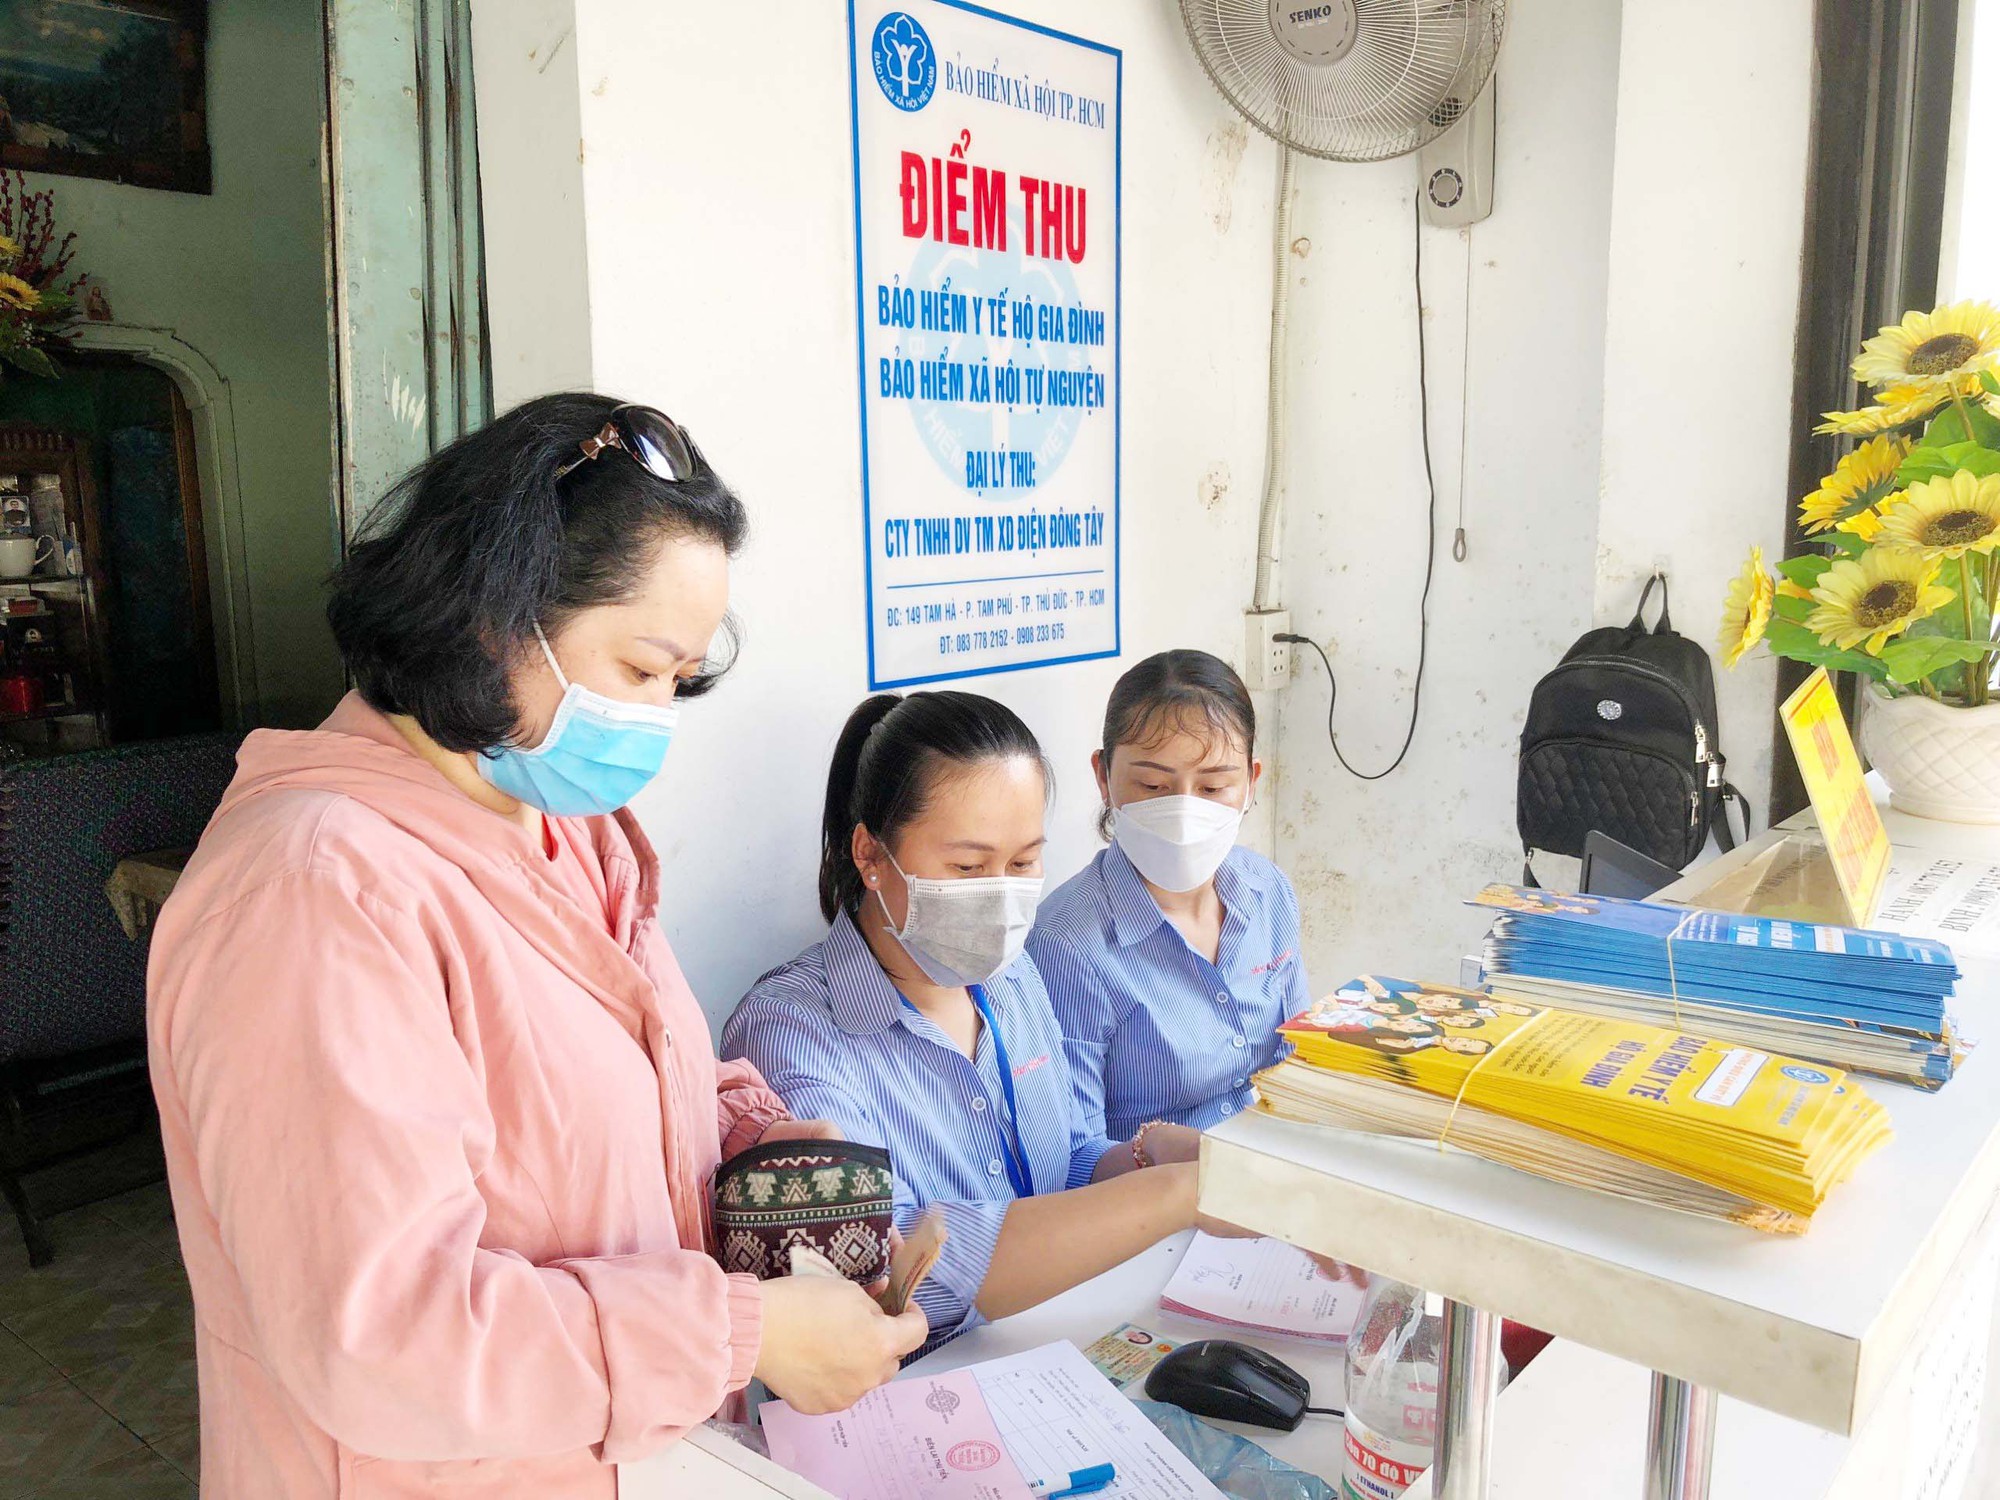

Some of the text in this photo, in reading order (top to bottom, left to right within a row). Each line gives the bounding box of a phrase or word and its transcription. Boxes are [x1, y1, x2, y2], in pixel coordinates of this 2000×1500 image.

[1289, 5, 1332, 24] SENKO
[945, 51, 1105, 129] BẢO HIỂM XÃ HỘI TP. HCM
[899, 128, 1087, 265] ĐIỂM THU
[877, 273, 1105, 348] BẢO HIỂM Y TẾ HỘ GIA ĐÌNH
[879, 345, 1105, 416] BẢO HIỂM XÃ HỘI TỰ NGUYỆN
[966, 442, 1036, 497] ĐẠI LÝ THU:
[884, 505, 1104, 559] CTY TNHH DV TM XD ĐIỆN ĐÔNG TÂY
[887, 608, 902, 627] ĐC:
[905, 606, 921, 625] 149
[923, 603, 942, 623] TAM
[977, 599, 994, 618] TAM
[997, 592, 1013, 616] PHÚ
[1089, 588, 1105, 606] HCM
[940, 635, 954, 655] ĐT:
[956, 633, 971, 653] 083
[973, 631, 988, 650] 778
[1016, 626, 1034, 645] 0908
[1036, 624, 1050, 643] 233
[1052, 622, 1065, 640] 675
[1600, 1051, 1635, 1064] GIA
[1610, 1040, 1647, 1053] HỘ
[1628, 1036, 1717, 1105] BẢO HIỂM Y TẾ
[1361, 1450, 1376, 1471] 70
[1380, 1461, 1399, 1483] độ
